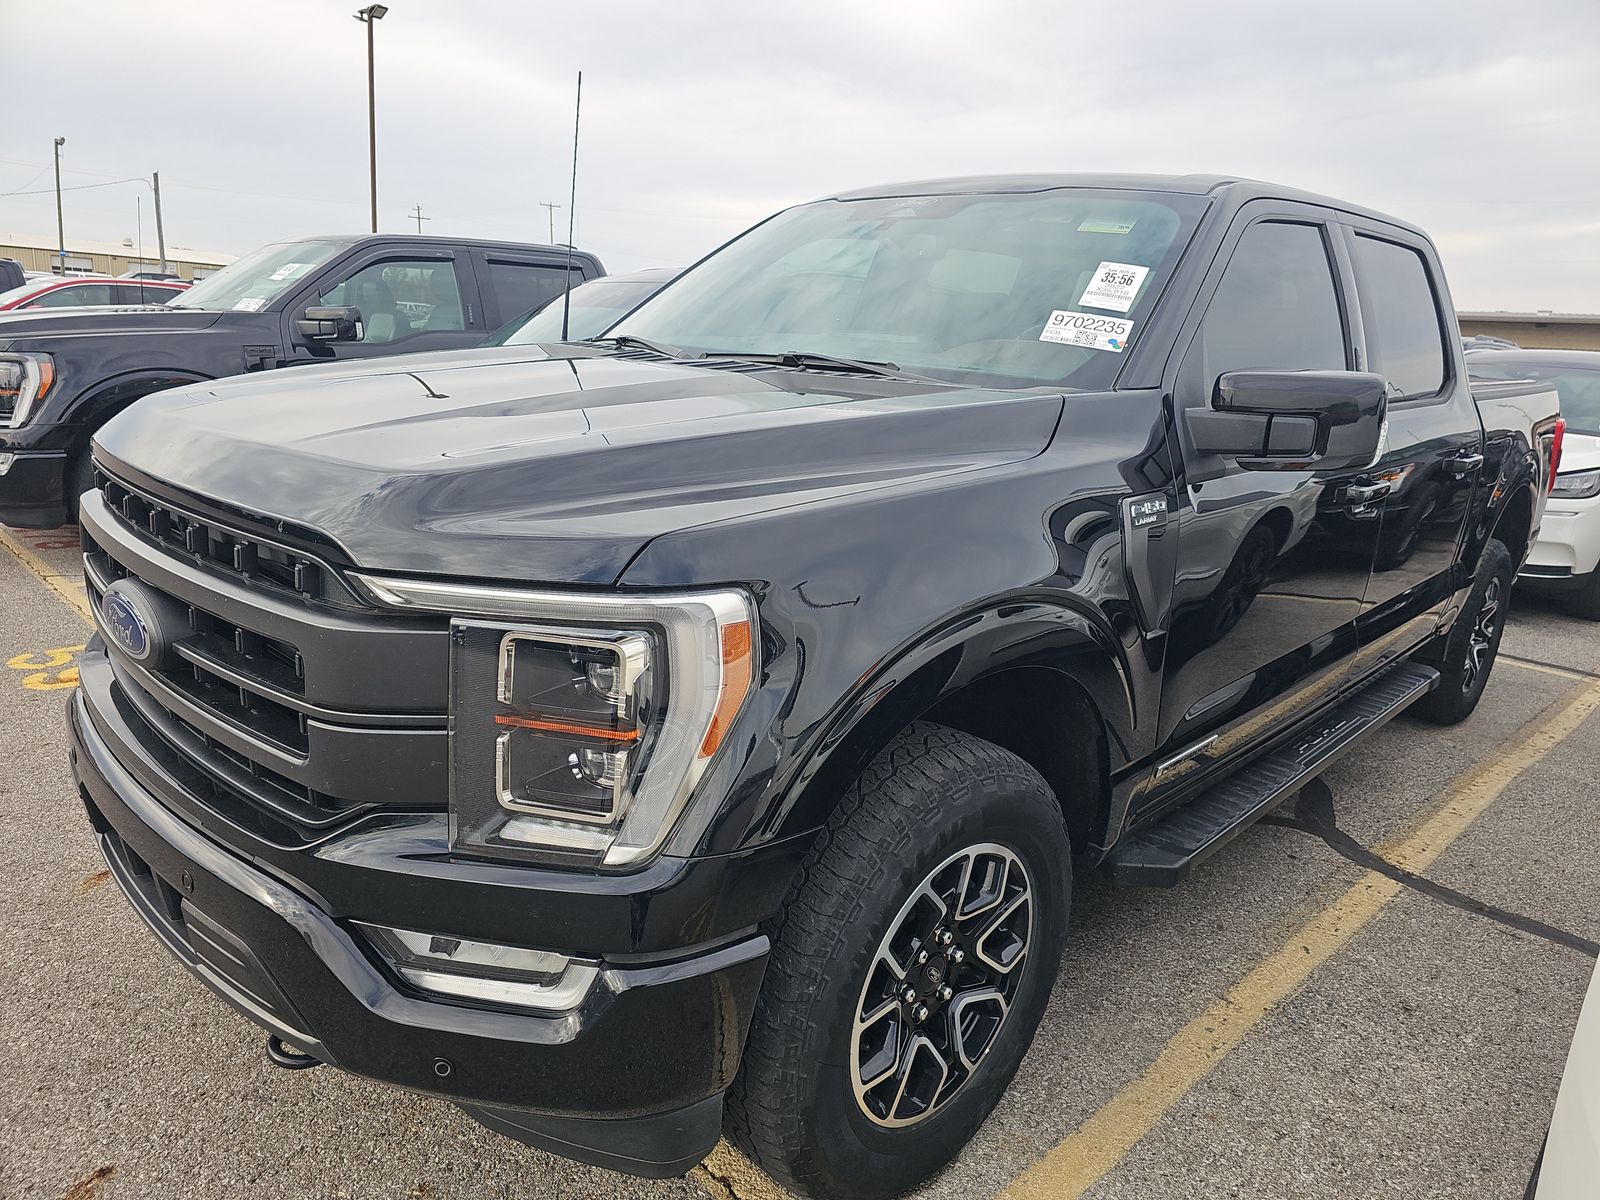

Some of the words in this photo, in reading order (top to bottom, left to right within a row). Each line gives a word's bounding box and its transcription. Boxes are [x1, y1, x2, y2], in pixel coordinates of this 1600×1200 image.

[1101, 272, 1135, 286] 35:56
[1052, 314, 1127, 335] 9702235
[1135, 515, 1157, 526] LARIAT
[108, 603, 133, 646] Ford
